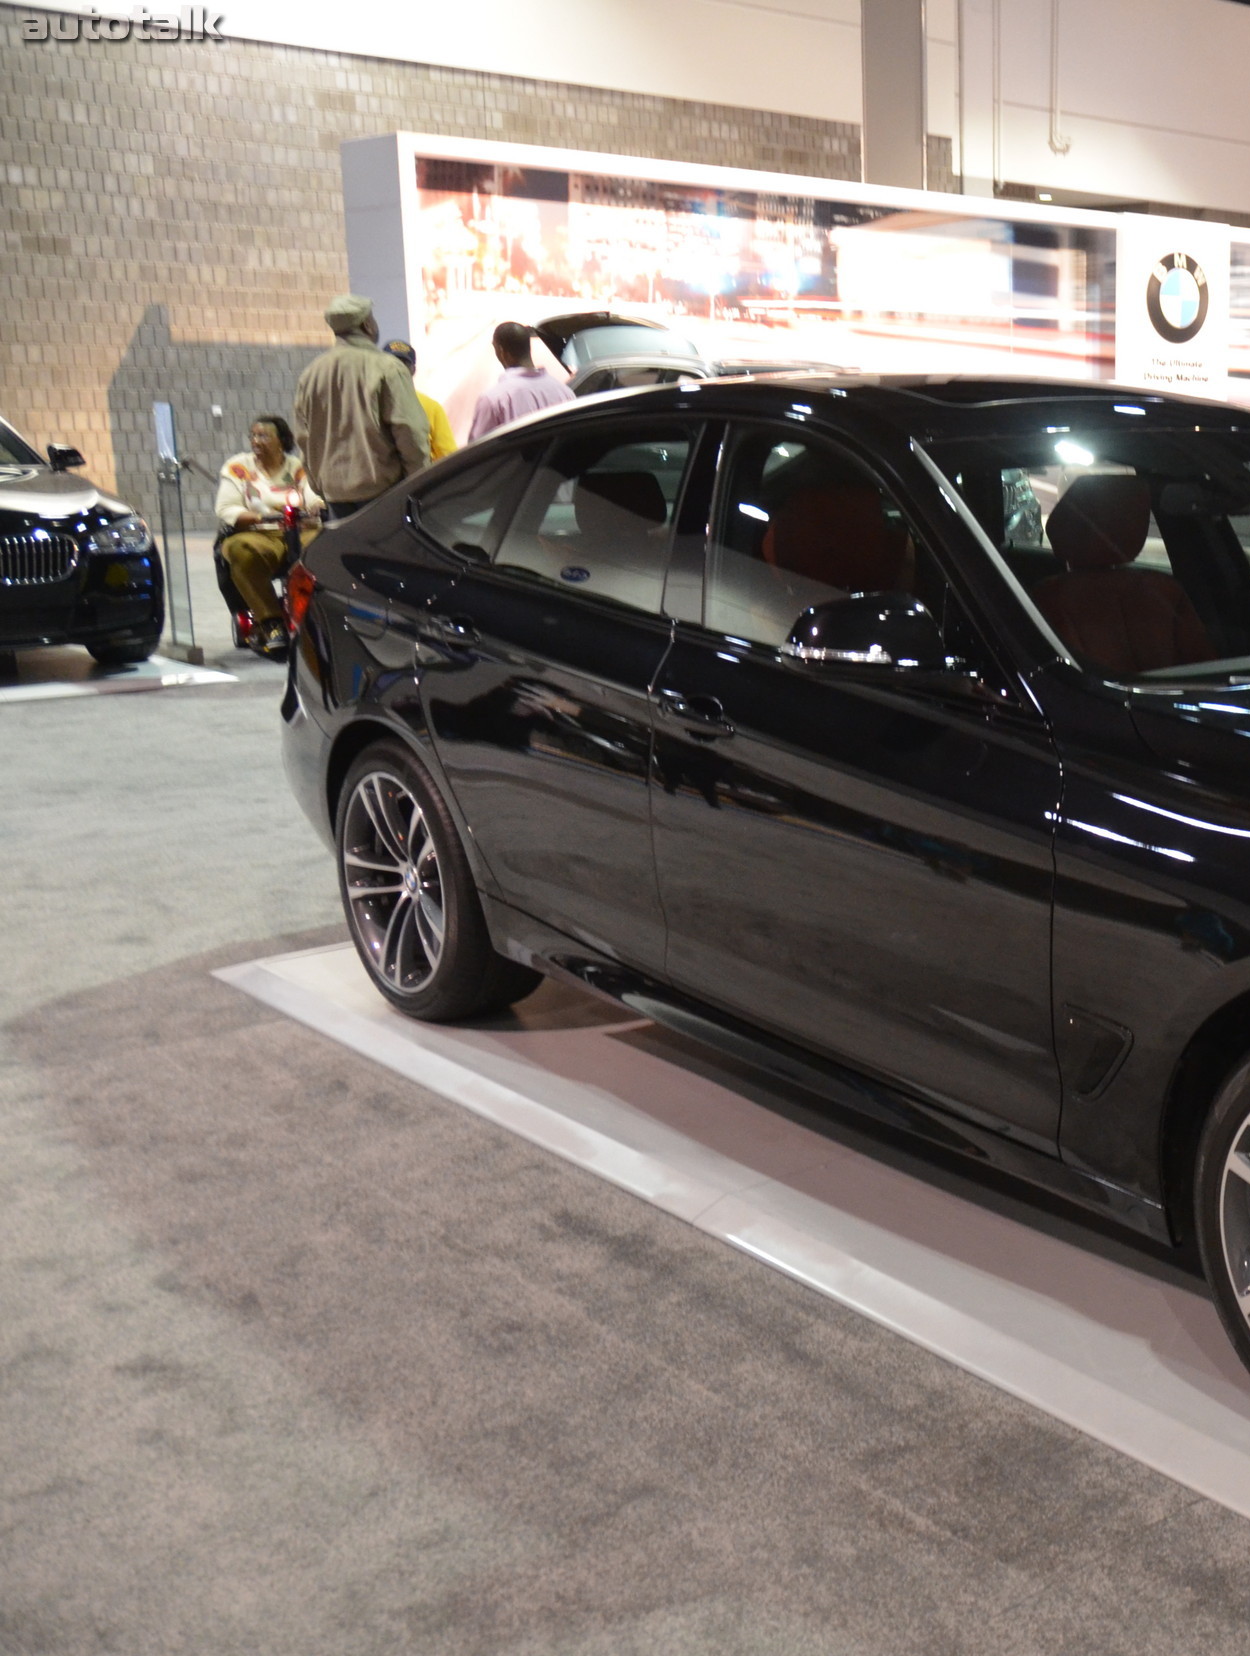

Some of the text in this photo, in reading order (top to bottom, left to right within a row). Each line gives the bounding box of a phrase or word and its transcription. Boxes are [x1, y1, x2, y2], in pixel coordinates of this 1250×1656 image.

[1170, 360, 1203, 369] Ultimate
[1143, 372, 1209, 384] Driving Machine
